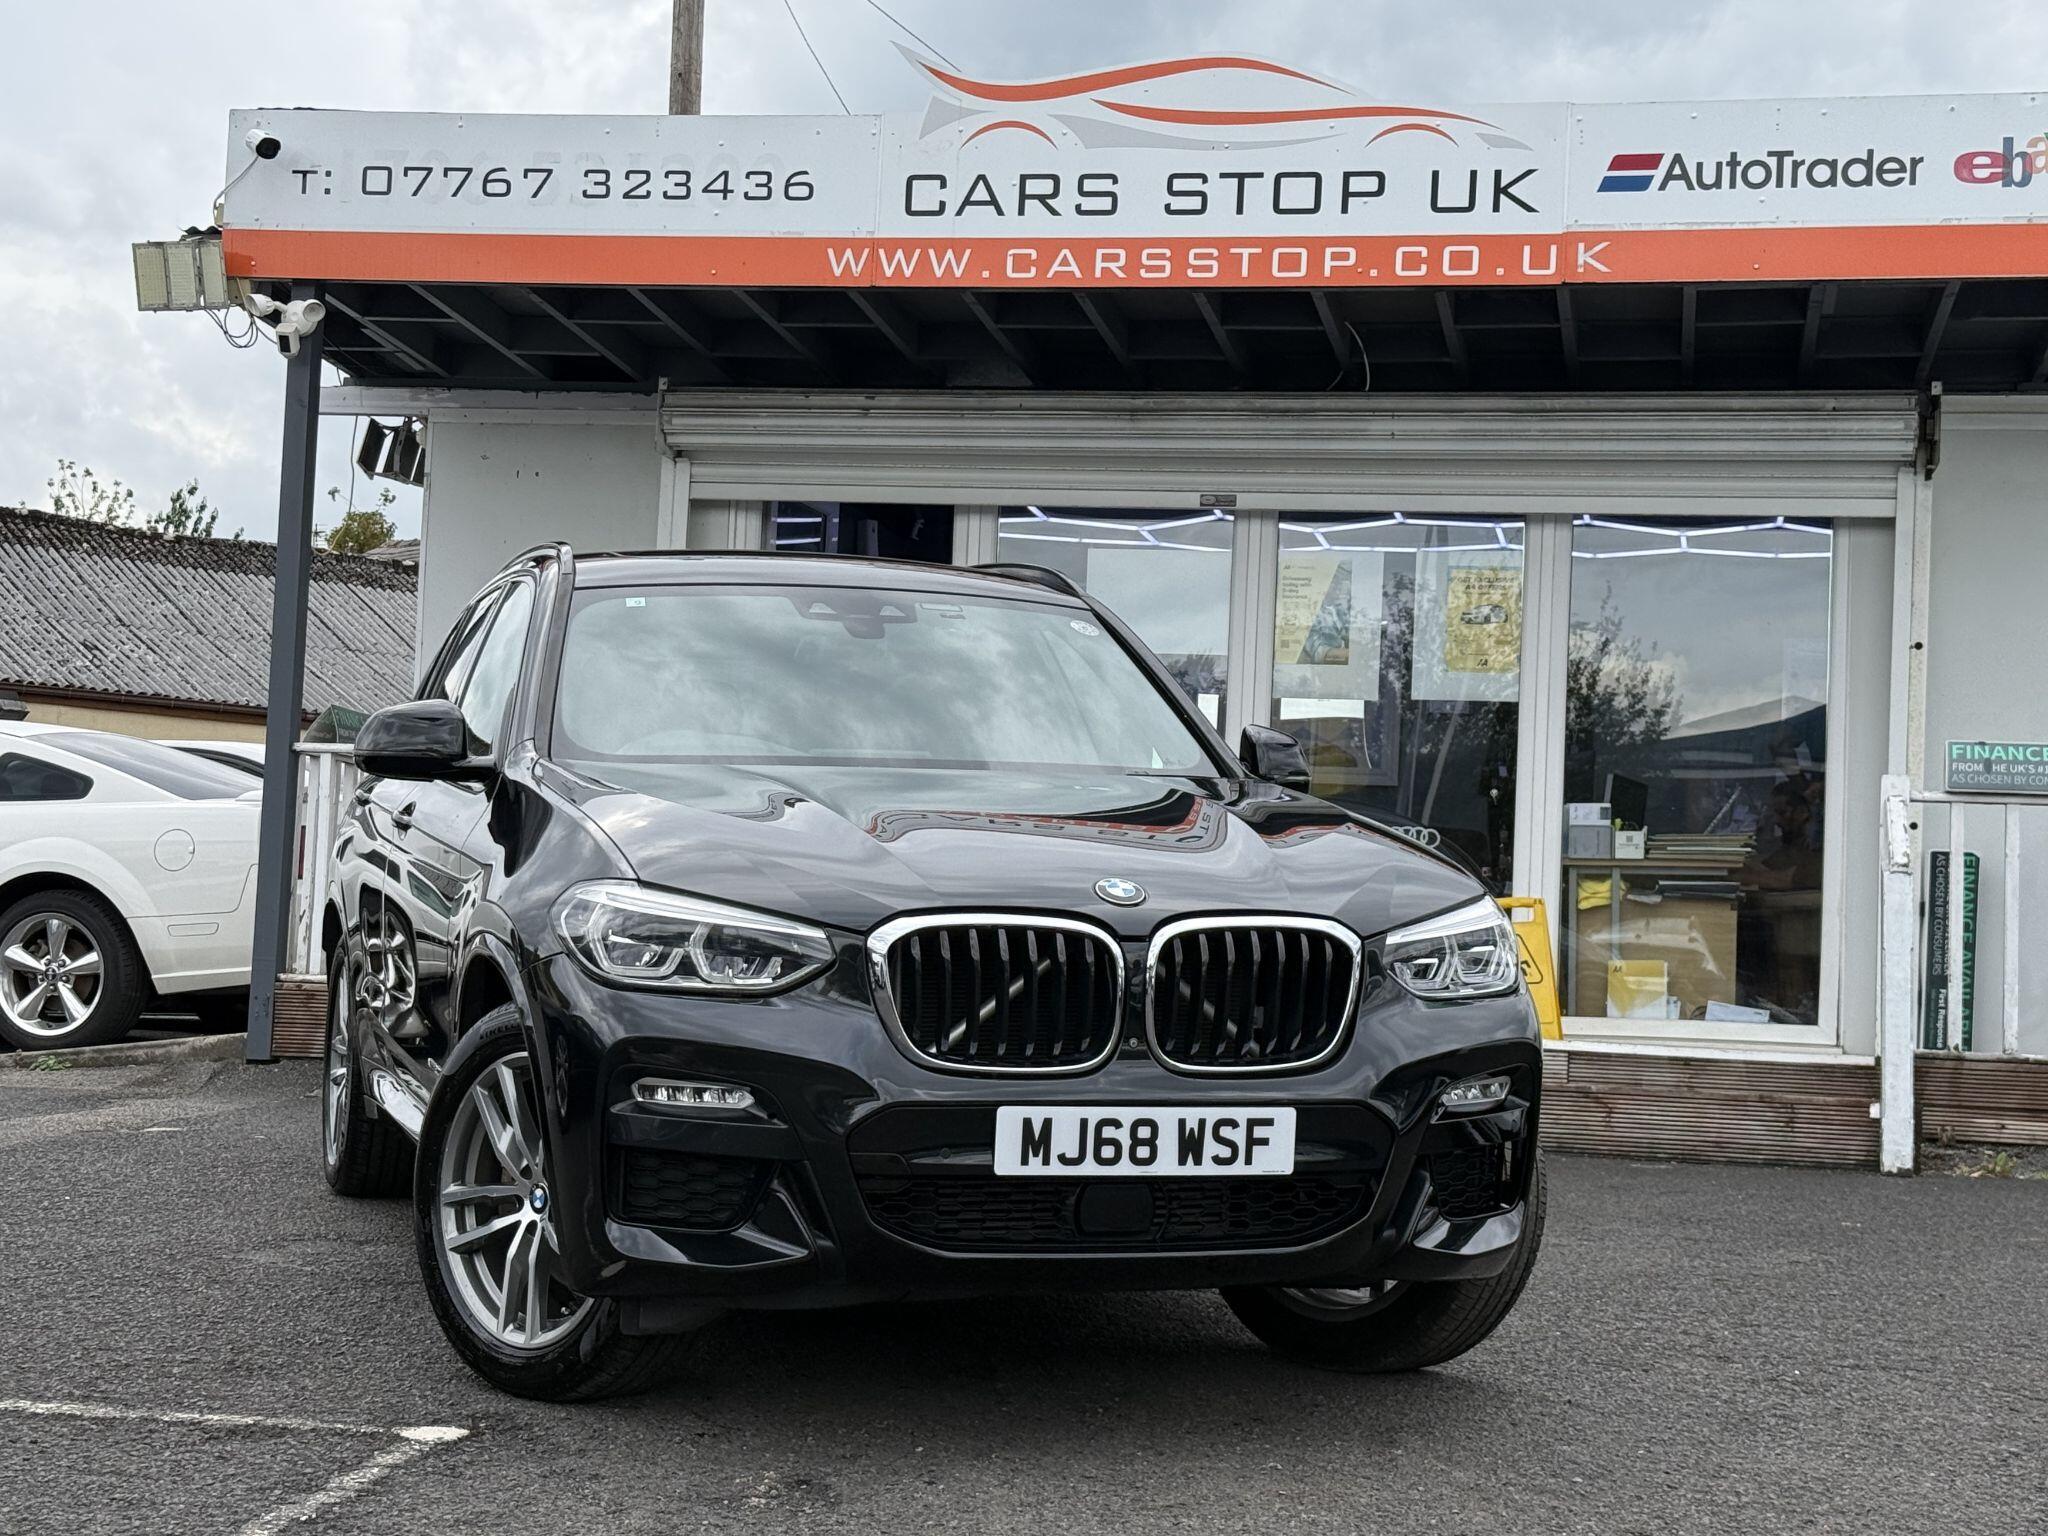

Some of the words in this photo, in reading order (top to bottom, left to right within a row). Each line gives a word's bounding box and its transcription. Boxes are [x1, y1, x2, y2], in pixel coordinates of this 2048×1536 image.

[1658, 149, 1925, 192] AutoTrader
[1953, 132, 2048, 188] eba
[291, 169, 333, 196] T:
[361, 165, 553, 199] 07767
[581, 169, 816, 202] 323436
[904, 173, 1120, 218] CARS
[1164, 169, 1386, 217] STOP
[1430, 168, 1539, 215] UK
[826, 241, 1612, 280] WWW.CARSSTOP.CO.UK
[1952, 762, 1982, 772] FROM
[1985, 763, 2008, 773] HE
[1952, 774, 1966, 784] AS
[1966, 774, 2011, 784] CHOSEN
[2014, 775, 2028, 785] BY
[1935, 866, 1945, 906] CHOSEN
[1934, 906, 1944, 918] BY
[1932, 919, 1944, 976] CONSUMERS
[1938, 988, 1947, 1008] First
[1936, 1008, 1946, 1049] Response
[1019, 1117, 1160, 1167] MJ68
[1177, 1117, 1275, 1167] WSF
